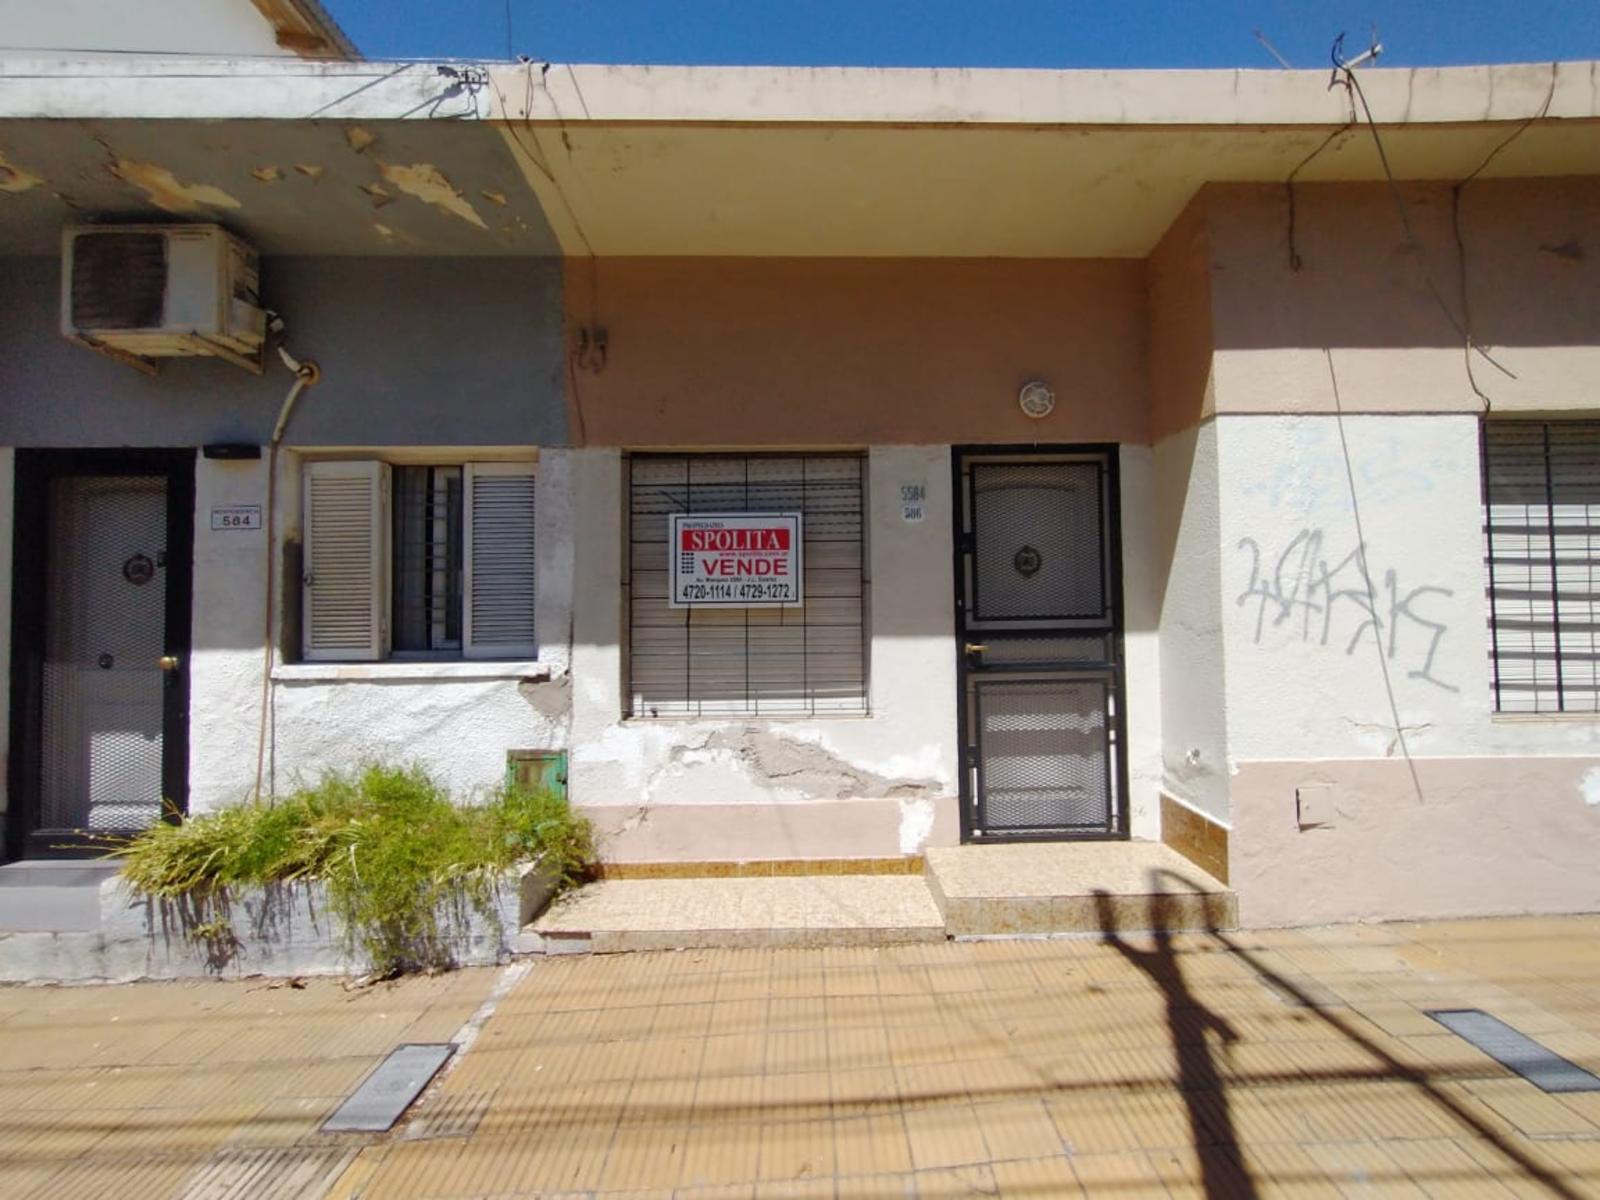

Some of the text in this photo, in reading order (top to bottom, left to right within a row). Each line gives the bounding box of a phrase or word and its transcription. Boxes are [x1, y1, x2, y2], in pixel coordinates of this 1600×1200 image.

[691, 530, 781, 550] SPOLITA
[702, 558, 788, 576] VENDE
[682, 584, 732, 600] 4720-1114
[739, 584, 790, 599] 4729-1272
